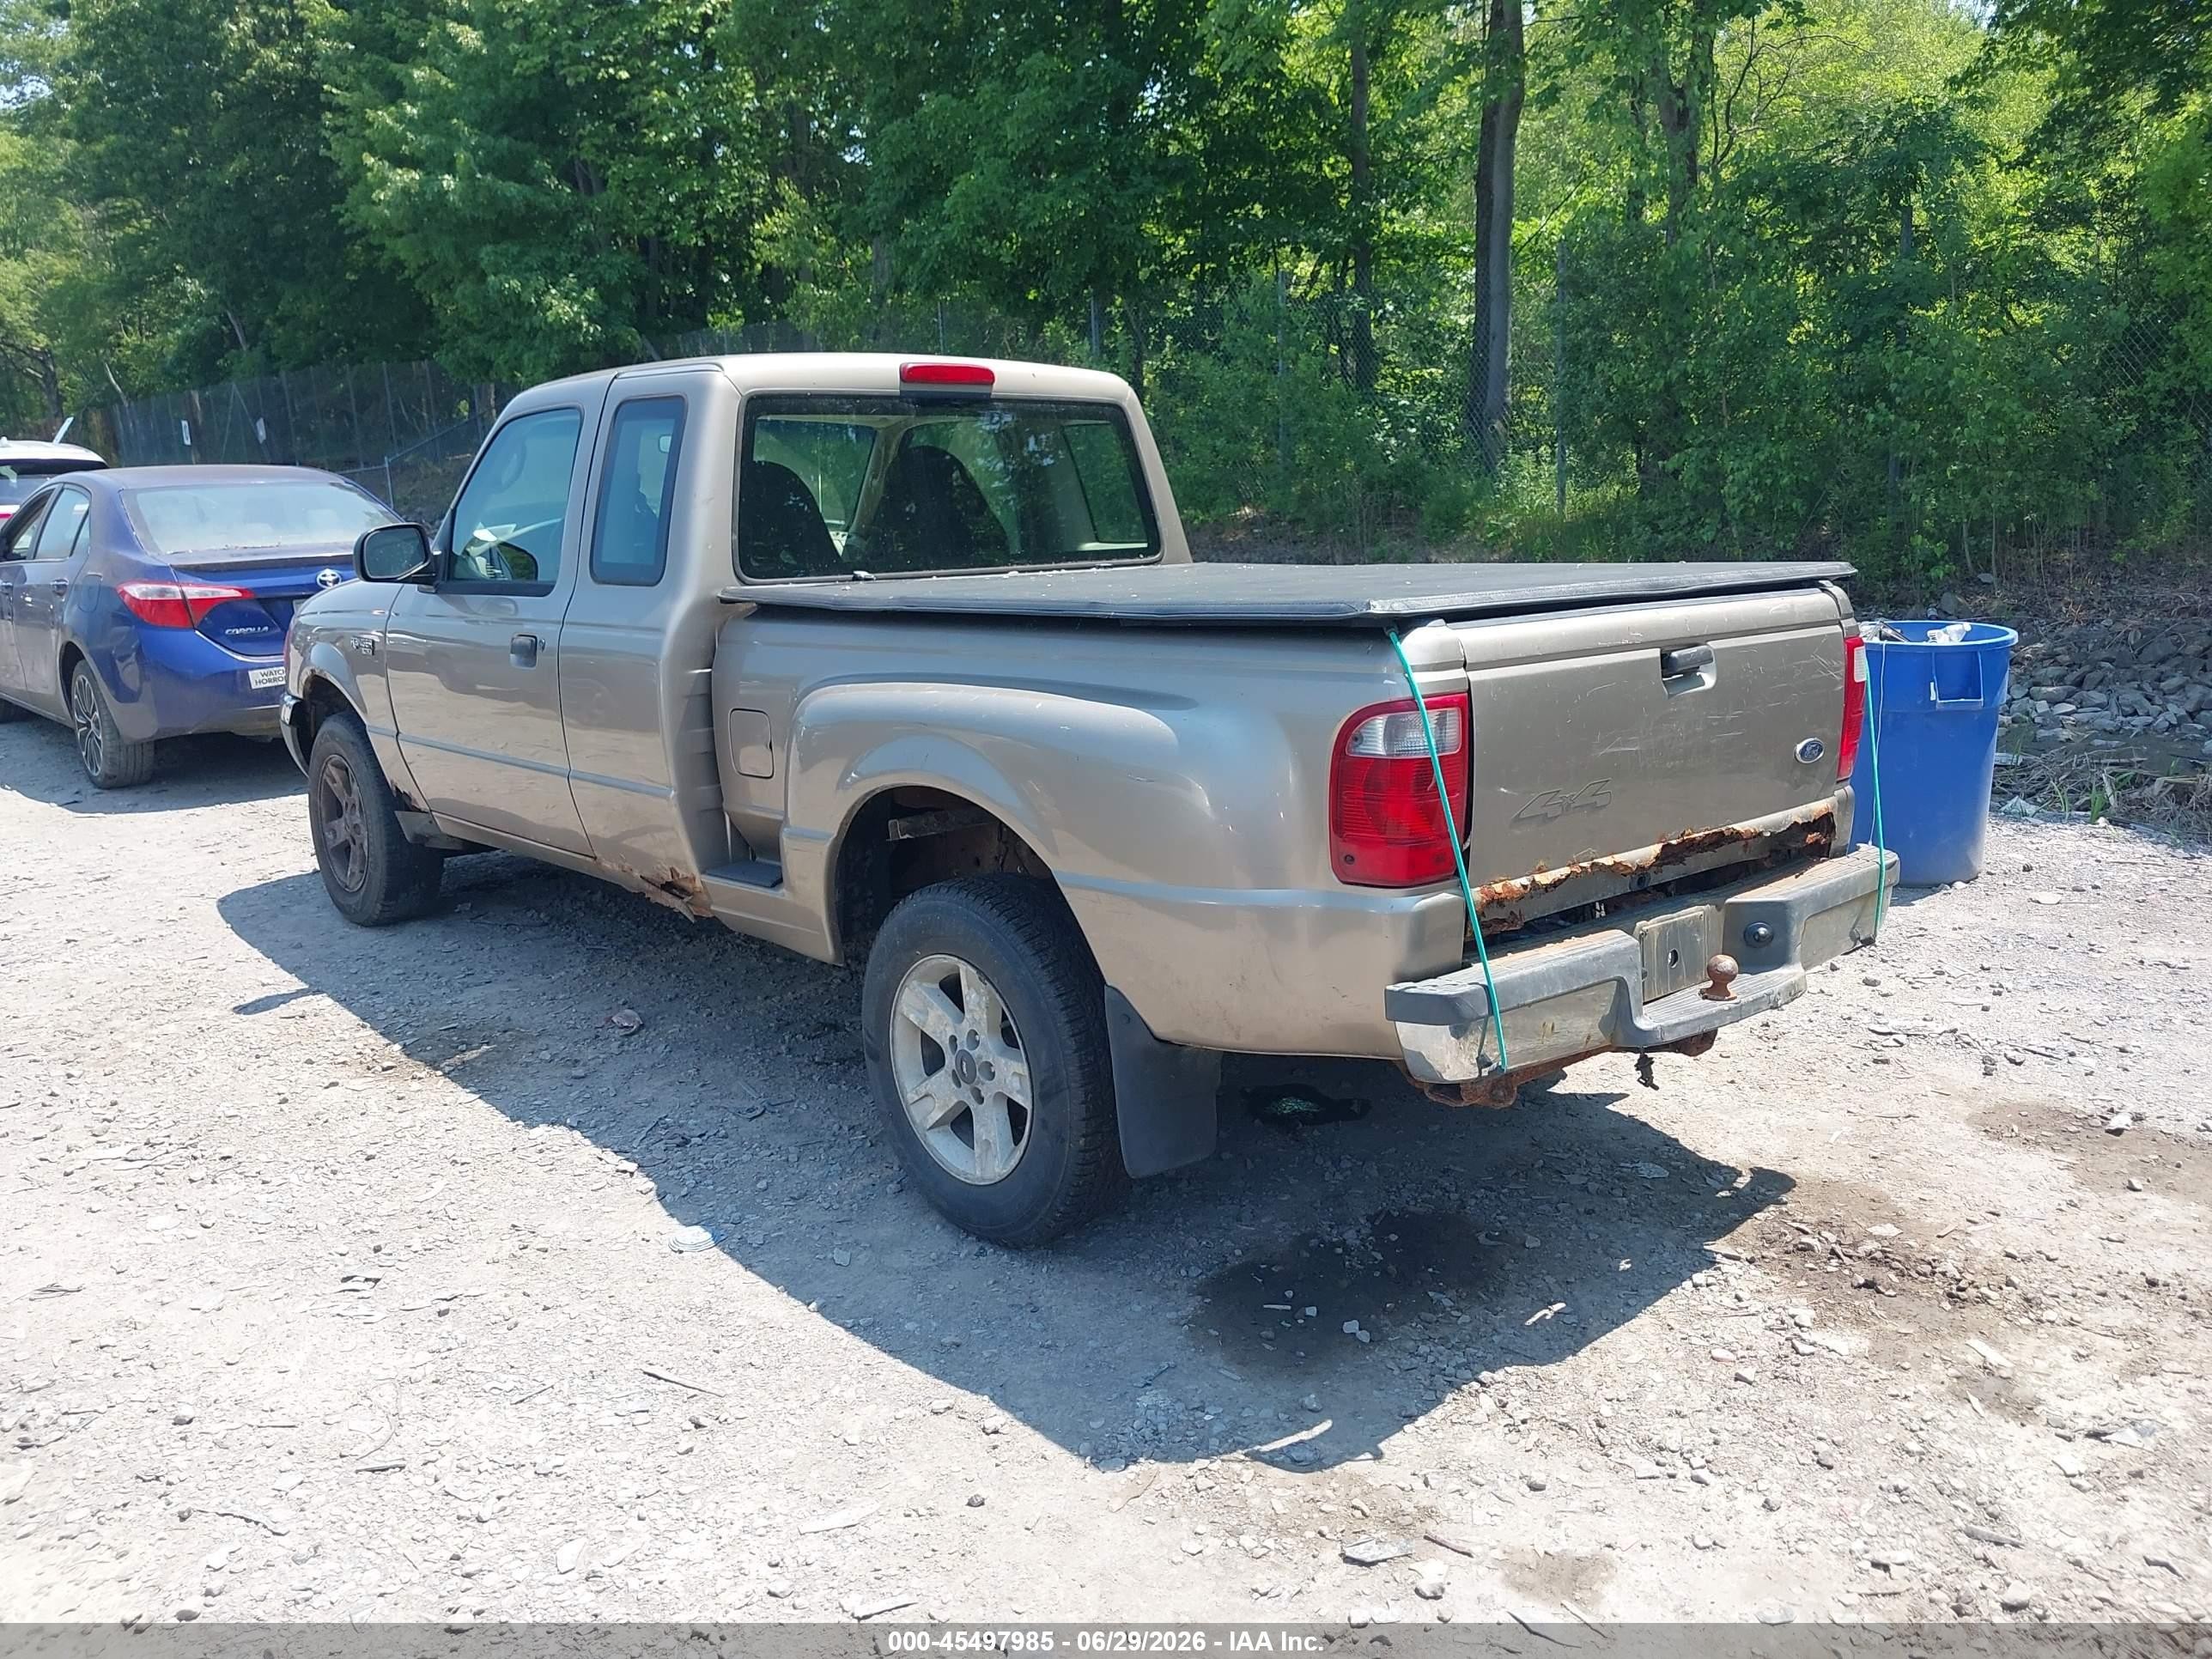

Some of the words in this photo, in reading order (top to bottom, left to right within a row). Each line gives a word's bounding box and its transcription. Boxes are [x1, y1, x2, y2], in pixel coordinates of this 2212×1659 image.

[225, 626, 269, 635] COROLLA
[259, 669, 284, 678] WATC
[254, 676, 285, 685] HORRO
